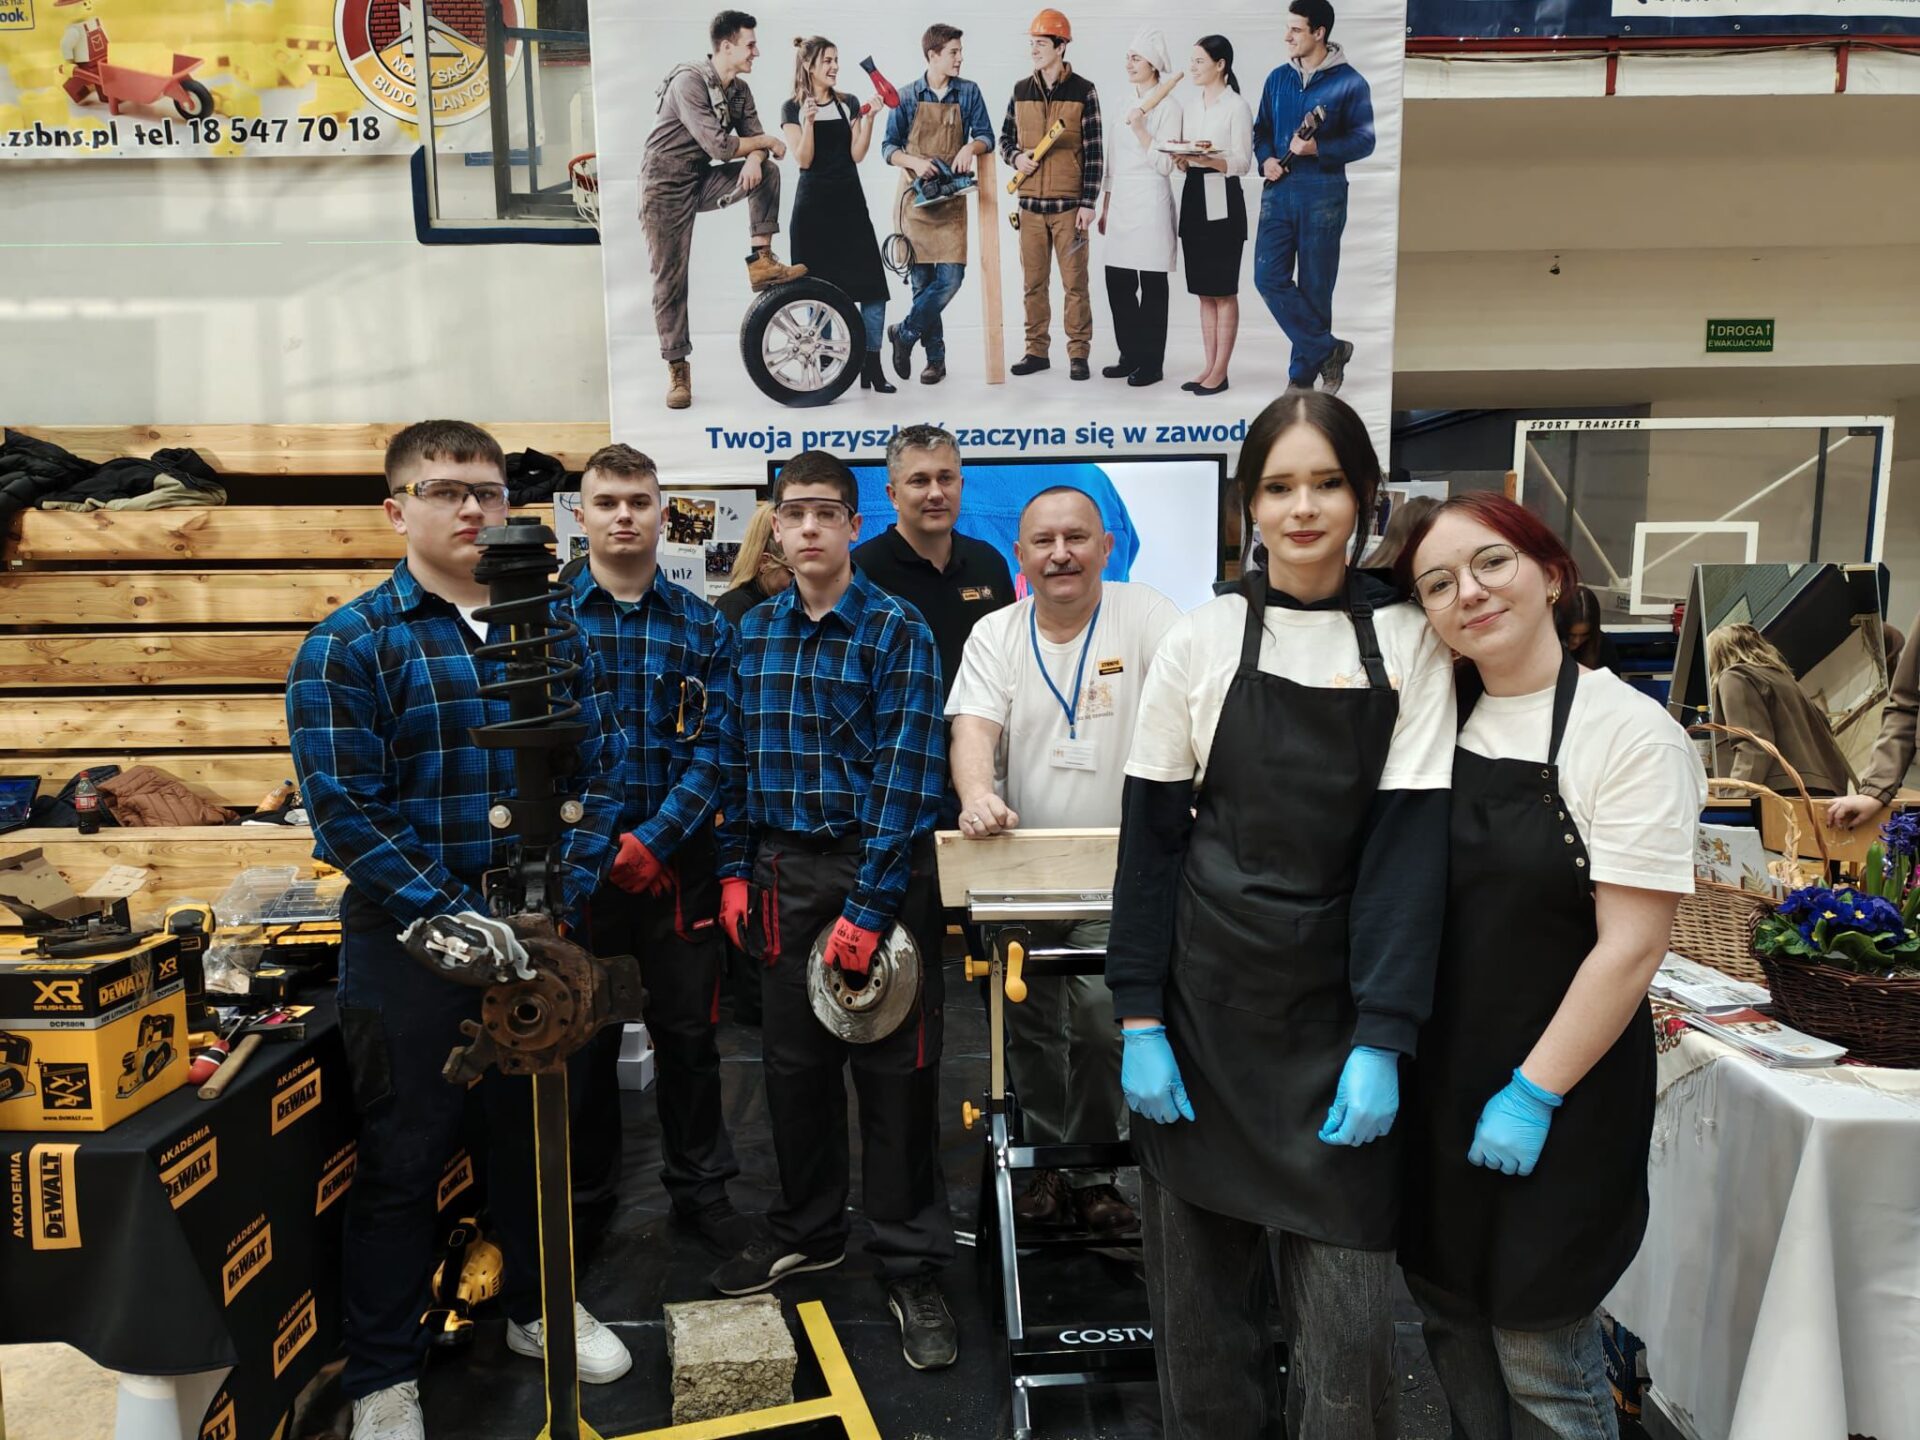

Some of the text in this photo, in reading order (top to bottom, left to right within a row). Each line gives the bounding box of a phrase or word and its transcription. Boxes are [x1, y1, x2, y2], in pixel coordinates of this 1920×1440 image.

[373, 75, 489, 112] BUDOLANYCH
[135, 119, 180, 146] tel.
[189, 119, 221, 144] 18
[230, 119, 288, 143] 547
[299, 117, 338, 142] 70
[348, 116, 381, 141] 18
[1717, 326, 1763, 336] DROGA
[705, 419, 1253, 453] Twoja przysz zaczyna się w zawod
[1531, 420, 1641, 429] SPORT TRANSFER
[277, 1057, 316, 1088] AKADEMIA
[277, 1079, 317, 1122] DEWALT
[160, 1125, 210, 1166] AKADEMIA
[10, 1151, 24, 1238] AKADEMIA
[41, 1151, 64, 1238] DEWALT
[226, 1213, 266, 1255] AKADEMIA
[228, 1237, 267, 1291] DEWALT
